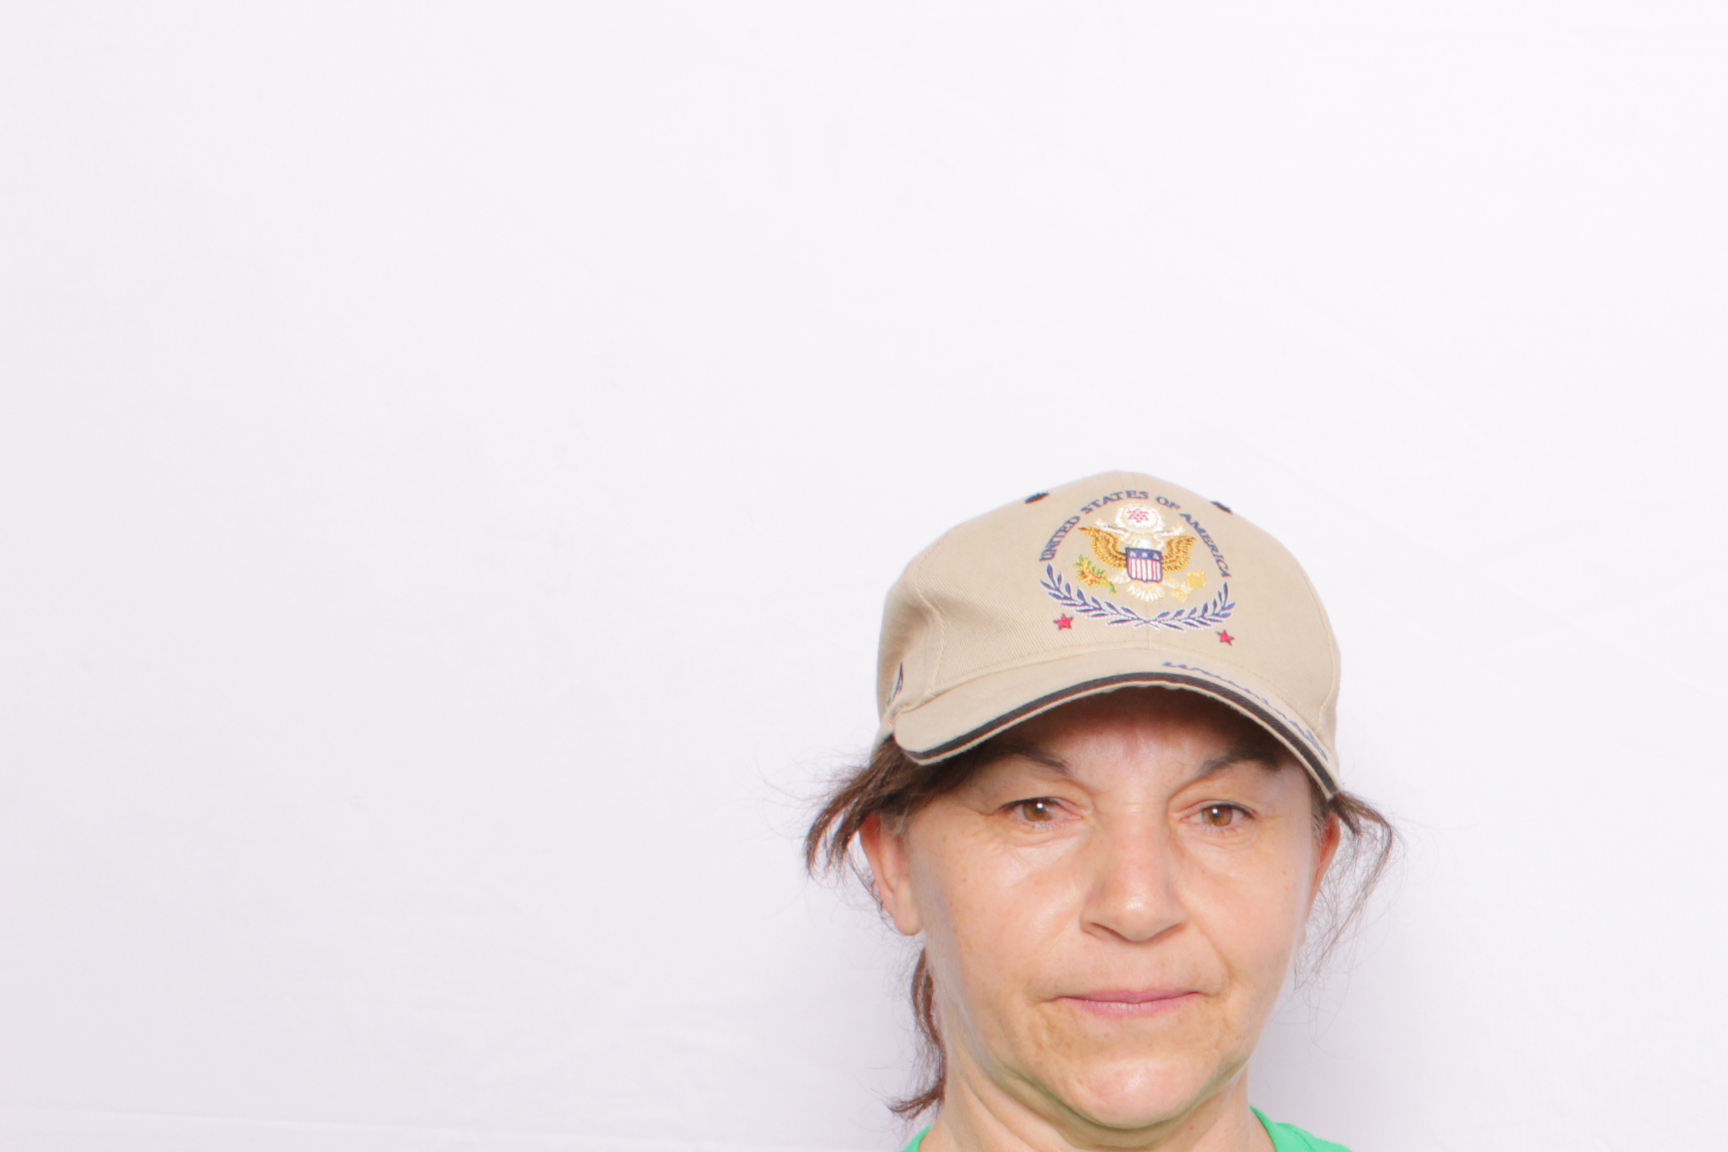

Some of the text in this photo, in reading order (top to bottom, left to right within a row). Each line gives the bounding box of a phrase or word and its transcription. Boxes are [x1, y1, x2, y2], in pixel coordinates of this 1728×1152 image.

[1039, 490, 1232, 578] UNITED STATES OF AMERICA
